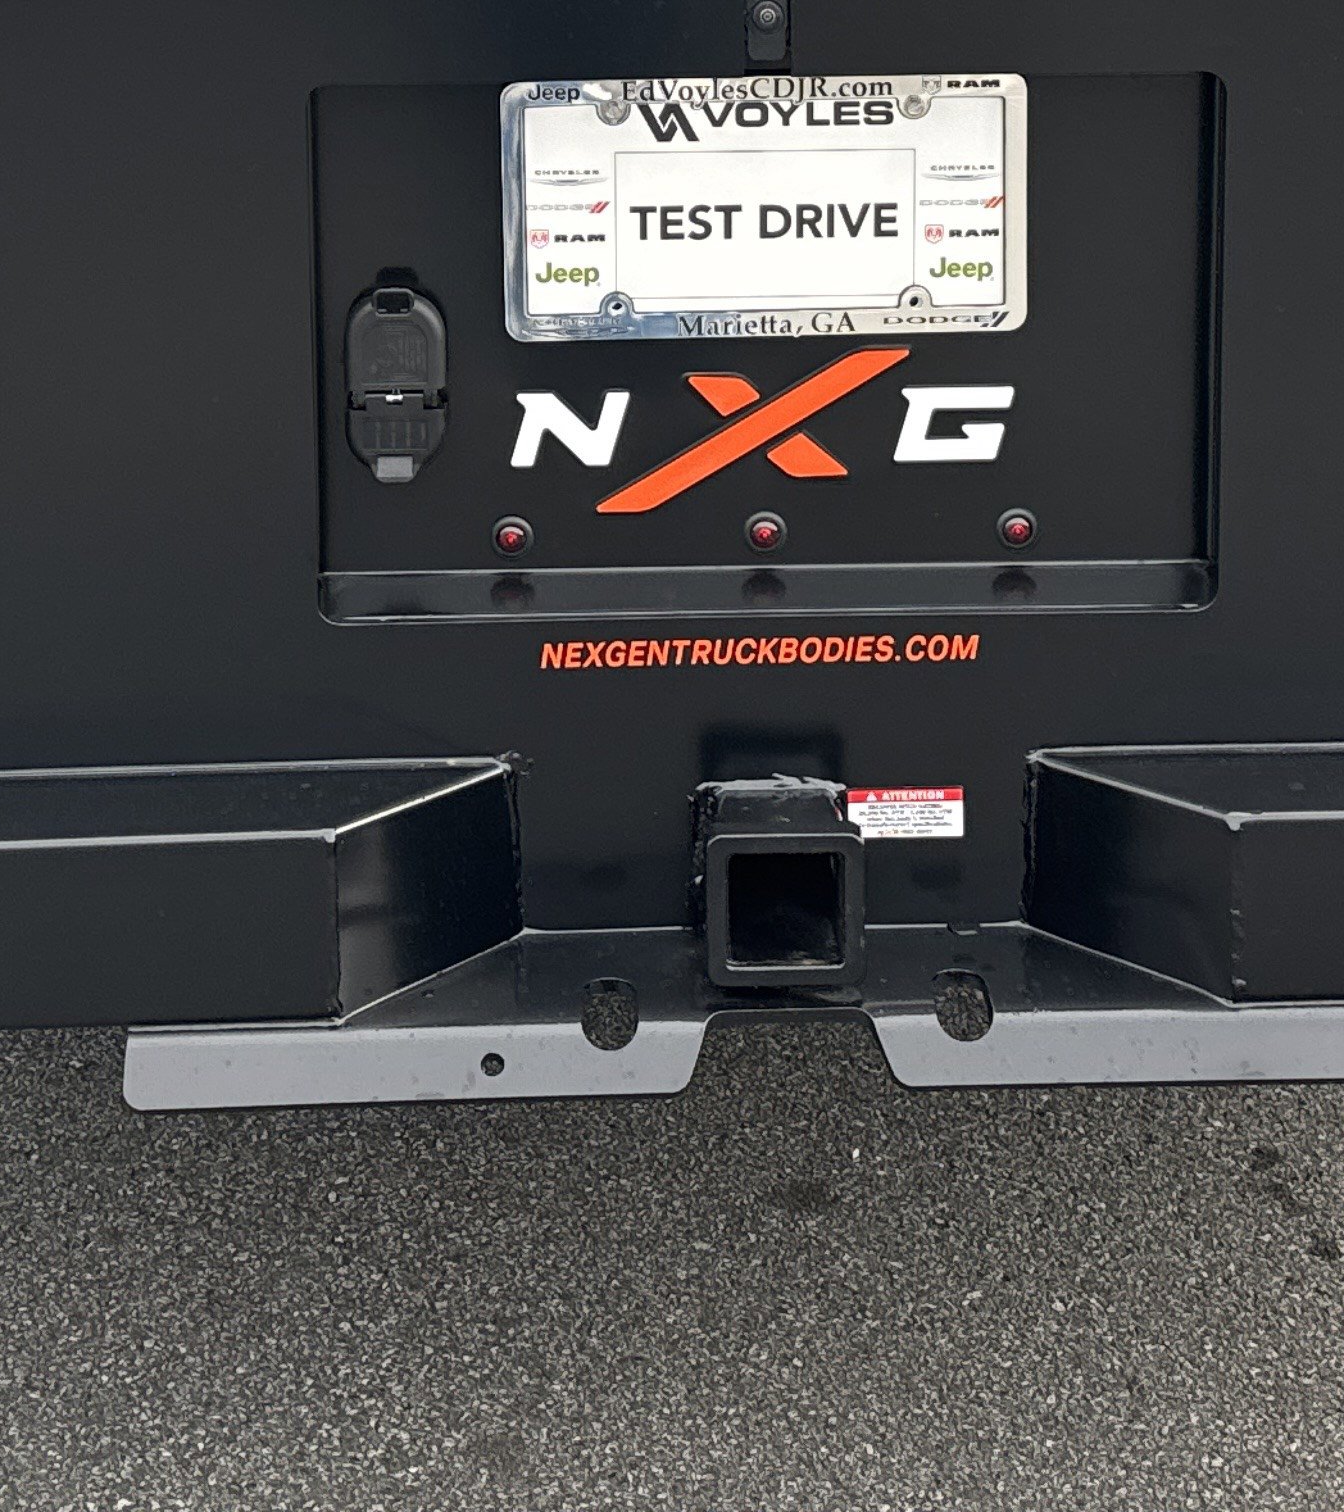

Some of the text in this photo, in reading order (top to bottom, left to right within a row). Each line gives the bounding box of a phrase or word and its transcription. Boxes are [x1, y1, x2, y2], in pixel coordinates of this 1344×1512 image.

[527, 83, 581, 103] Jeep
[621, 75, 894, 109] EdVoylesCDJR.com
[946, 79, 1001, 88] RAM
[703, 100, 895, 128] VOYLES
[628, 202, 899, 241] TEST DRIVE
[948, 228, 1000, 238] RAM
[553, 234, 606, 243] RAM
[534, 261, 600, 287] Jeep
[929, 256, 994, 282] Jeep
[677, 311, 857, 337] Marietta, GA
[882, 315, 992, 325] DODGE
[539, 633, 981, 670] NEXGENTRUCKBODIES.COM
[881, 790, 945, 800] ATTENTION
